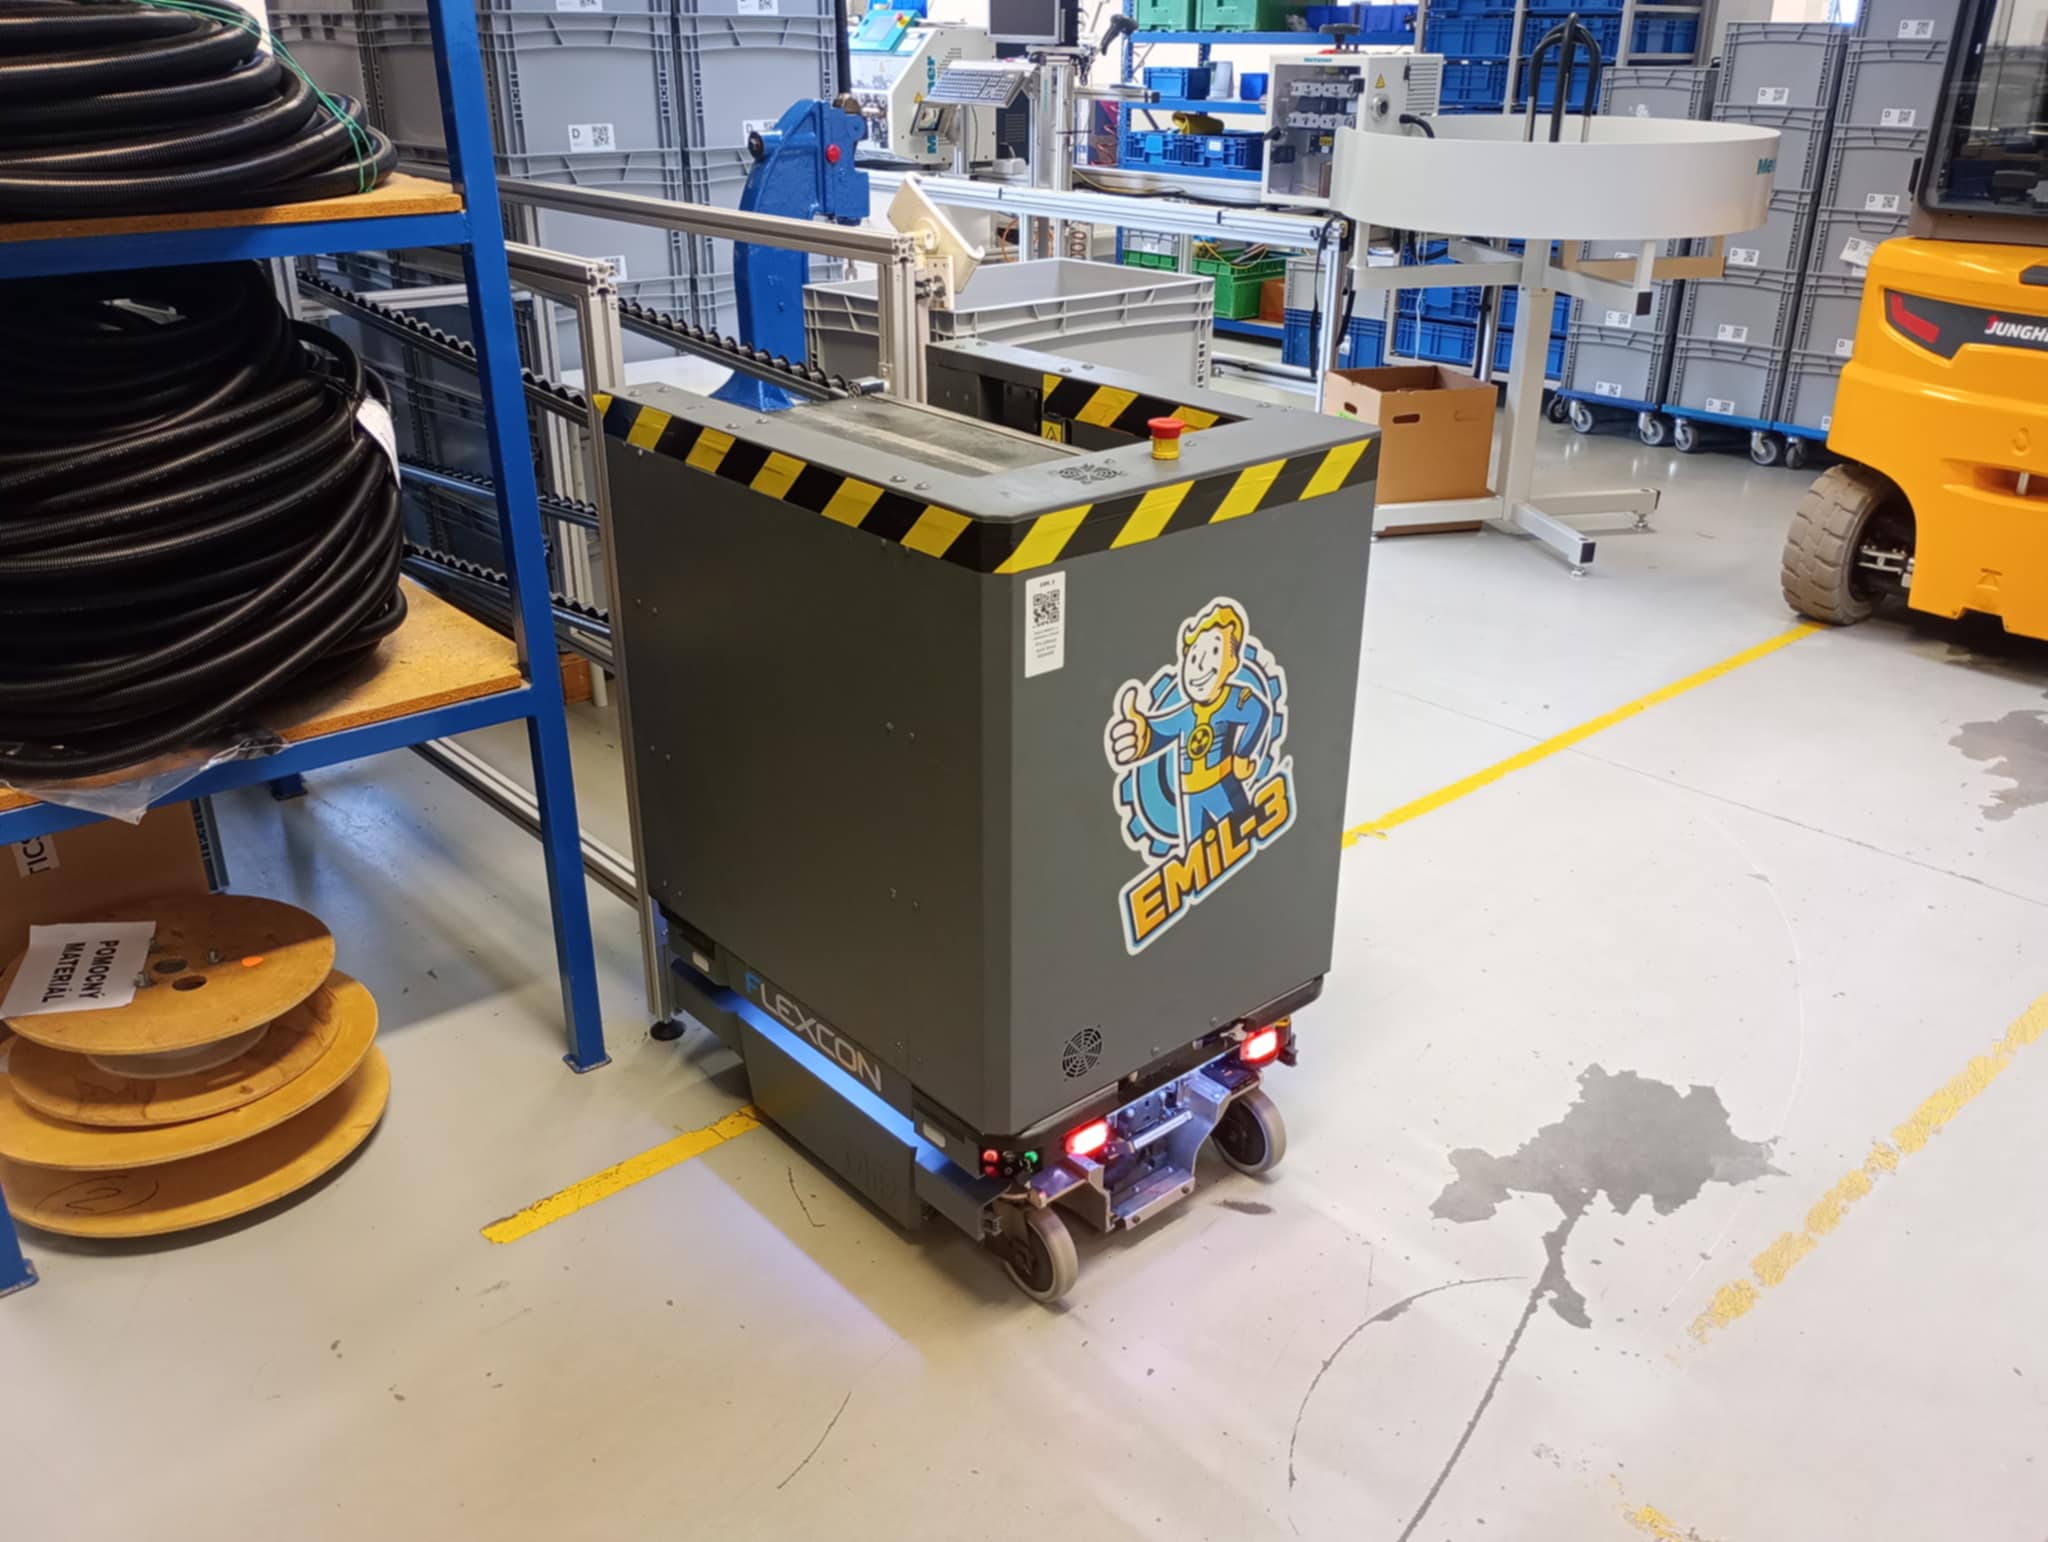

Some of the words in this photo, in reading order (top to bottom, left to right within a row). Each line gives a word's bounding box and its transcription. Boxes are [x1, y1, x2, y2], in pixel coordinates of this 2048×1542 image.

[571, 128, 580, 139] D
[41, 941, 87, 1003] MATERIÁL
[78, 939, 120, 1000] POMOCNÝ
[744, 971, 883, 1092] FLEXCON
